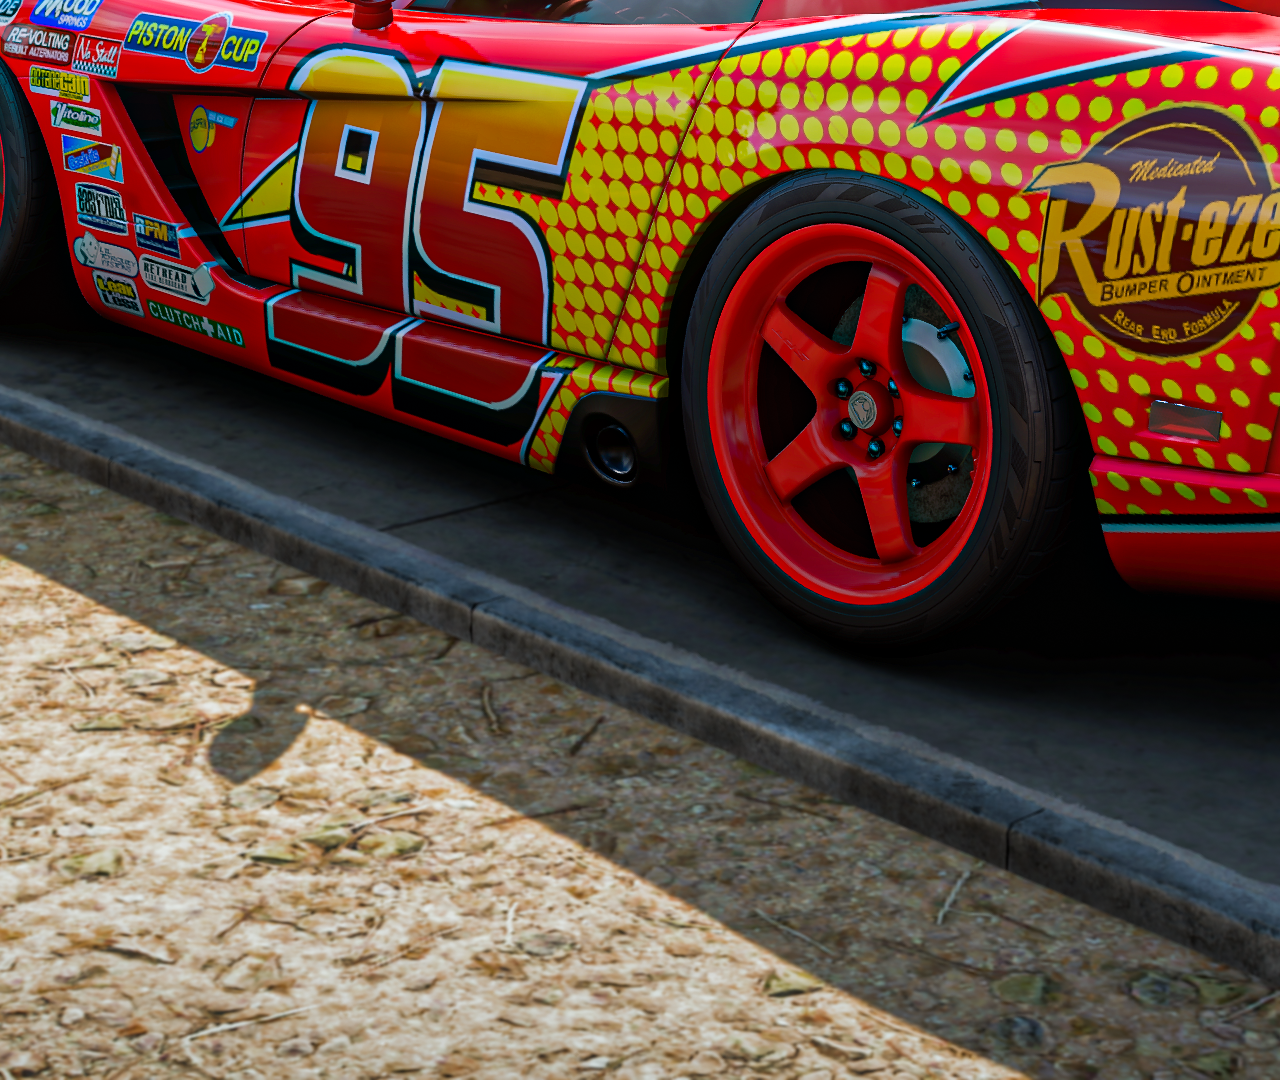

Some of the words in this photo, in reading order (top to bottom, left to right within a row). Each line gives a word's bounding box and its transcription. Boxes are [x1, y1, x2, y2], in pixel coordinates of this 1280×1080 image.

[58, 14, 88, 28] SPRINGS
[4, 42, 28, 55] REBUILT
[29, 46, 69, 63] ALTERNATORS
[7, 27, 71, 51] RE-VOLTING
[76, 37, 91, 60] No
[92, 40, 118, 64] Stall
[127, 20, 192, 52] PISTON
[221, 35, 260, 62] CUP
[53, 102, 100, 126] Vitoline
[1129, 151, 1220, 183] Medicated
[266, 43, 588, 446] 95
[144, 262, 187, 283] RETREAD
[1100, 276, 1169, 302] BUMPER
[1176, 266, 1268, 294] OINTMENT
[149, 301, 202, 332] CLUTCH
[217, 324, 243, 346] AID
[1112, 309, 1144, 336] REAR
[1151, 325, 1177, 340] END
[1182, 298, 1234, 335] FORMULA
